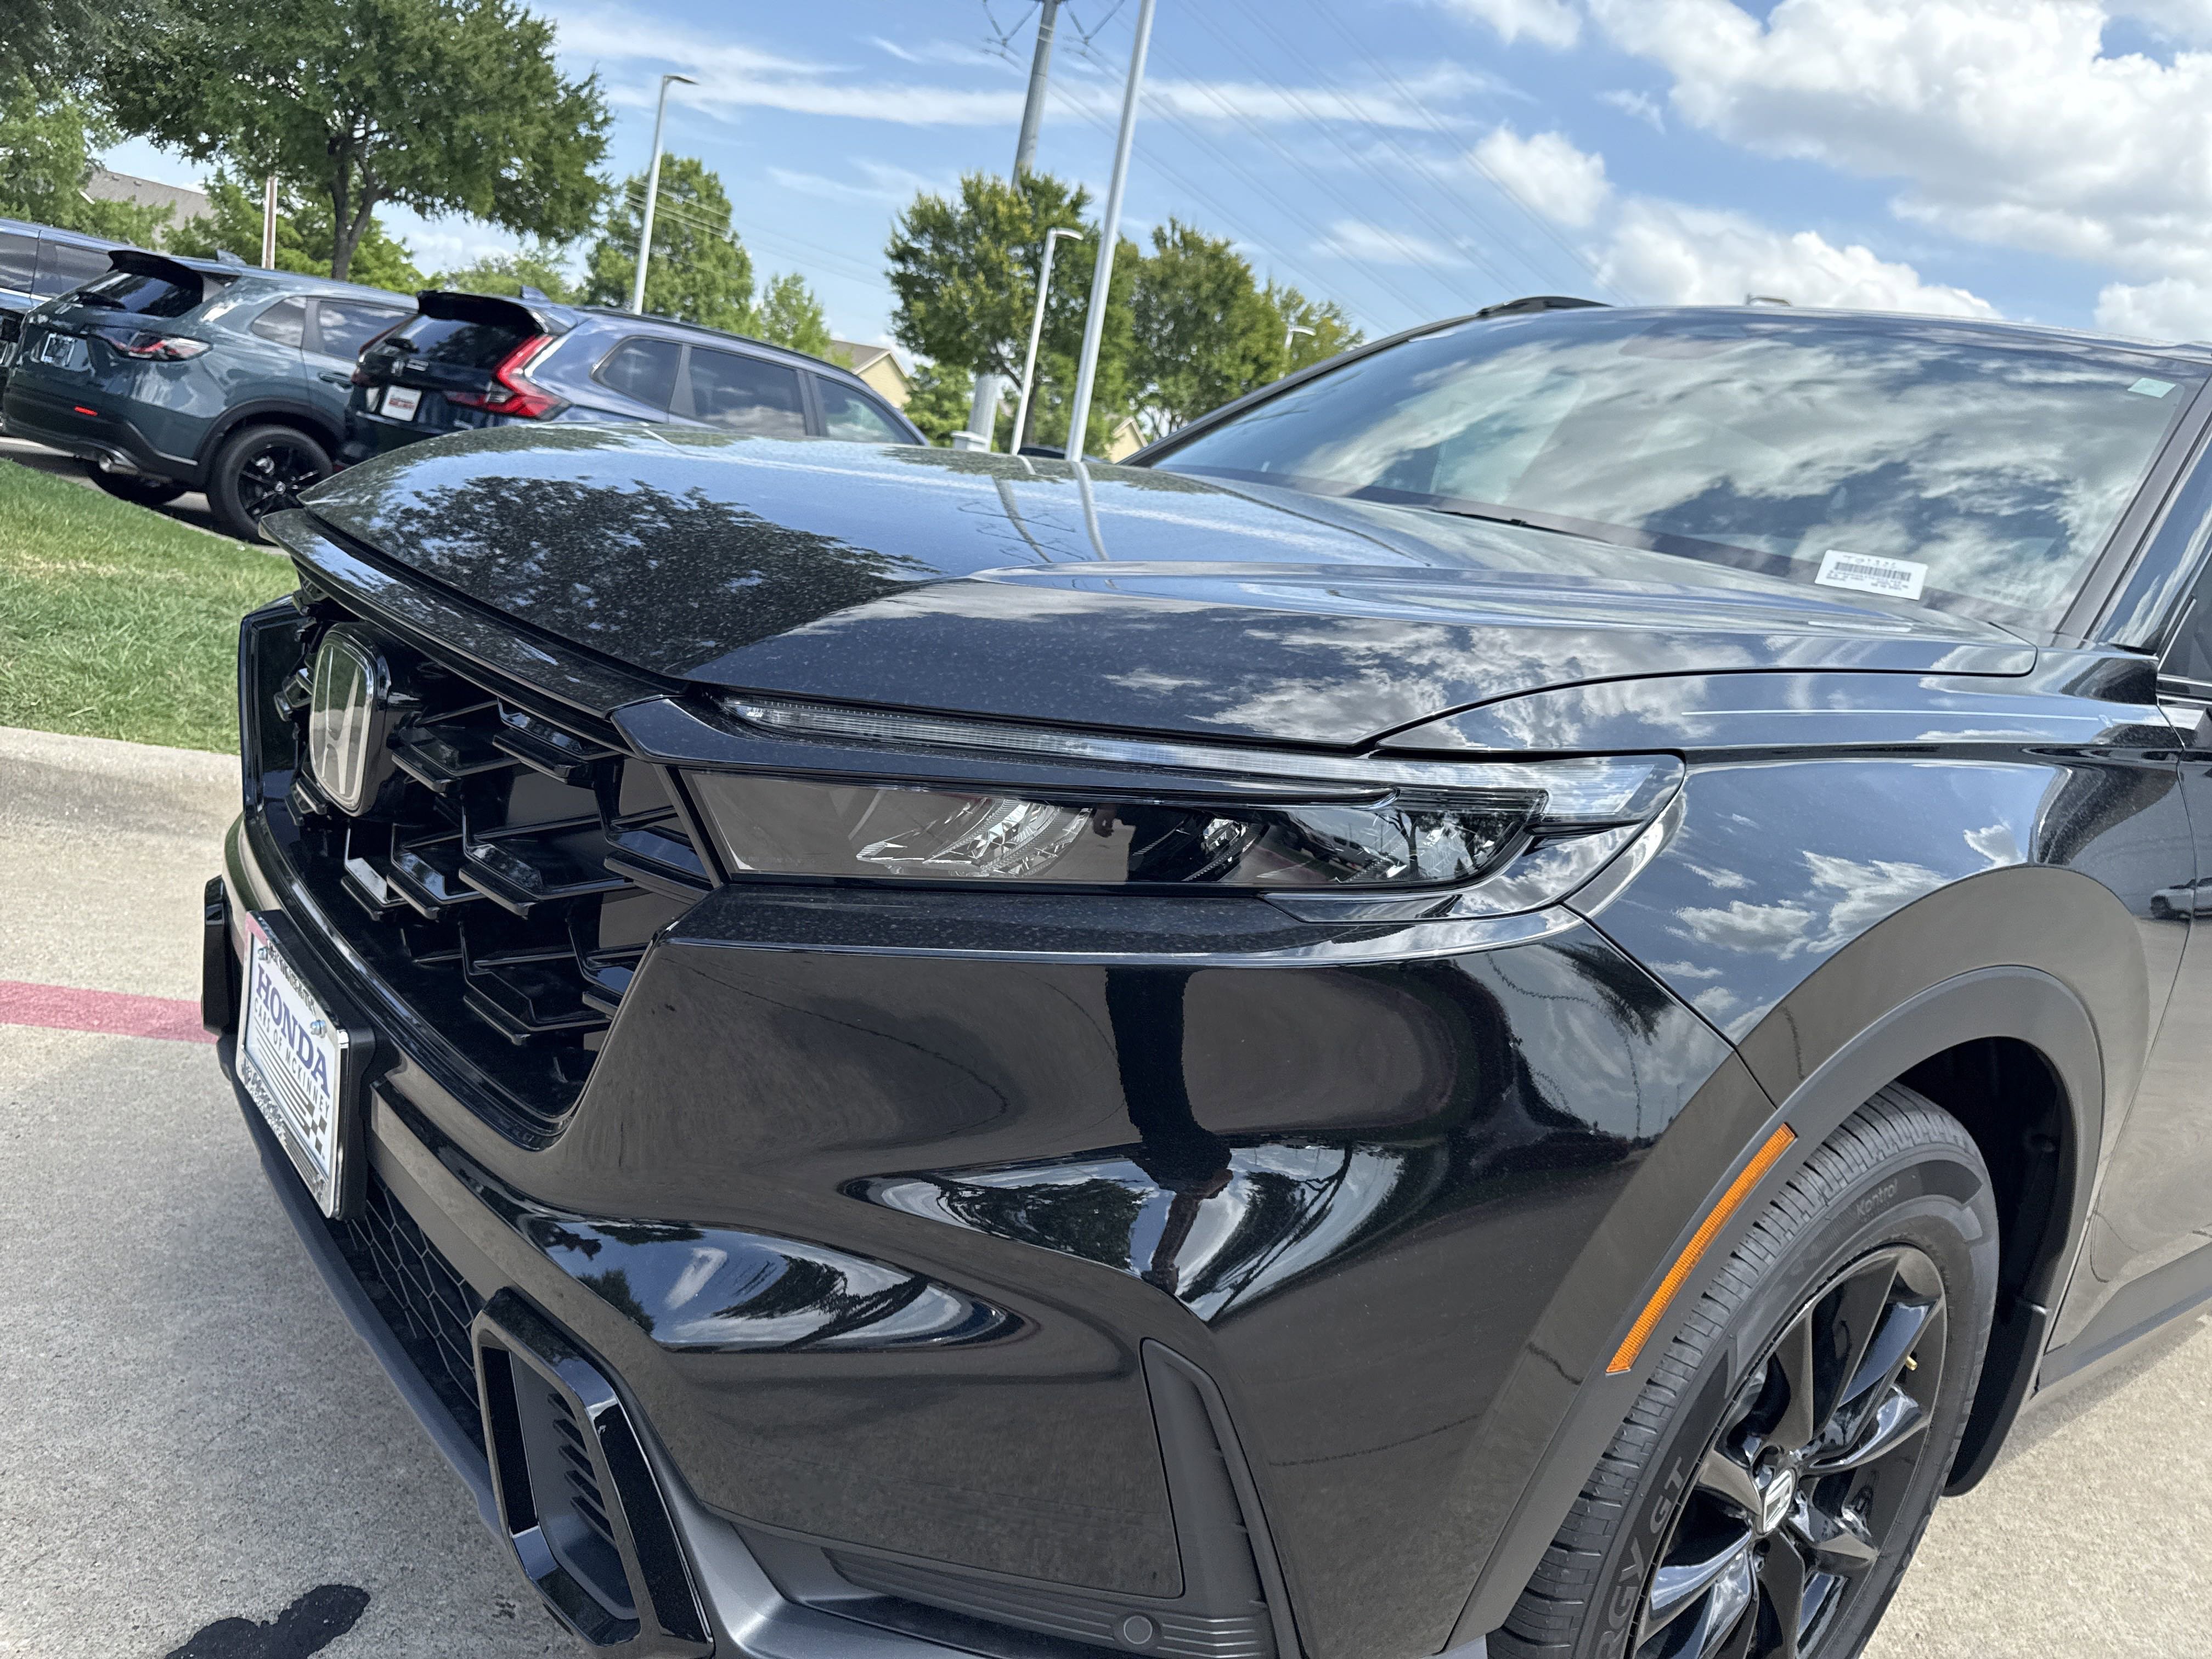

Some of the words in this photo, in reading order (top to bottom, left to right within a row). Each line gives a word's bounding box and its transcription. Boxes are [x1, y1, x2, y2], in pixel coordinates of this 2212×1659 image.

[255, 997, 270, 1033] CARS
[273, 1029, 283, 1051] OF
[285, 1047, 330, 1119] MCKINNEY
[256, 963, 330, 1099] HONDA
[1650, 1456, 1684, 1534] GT
